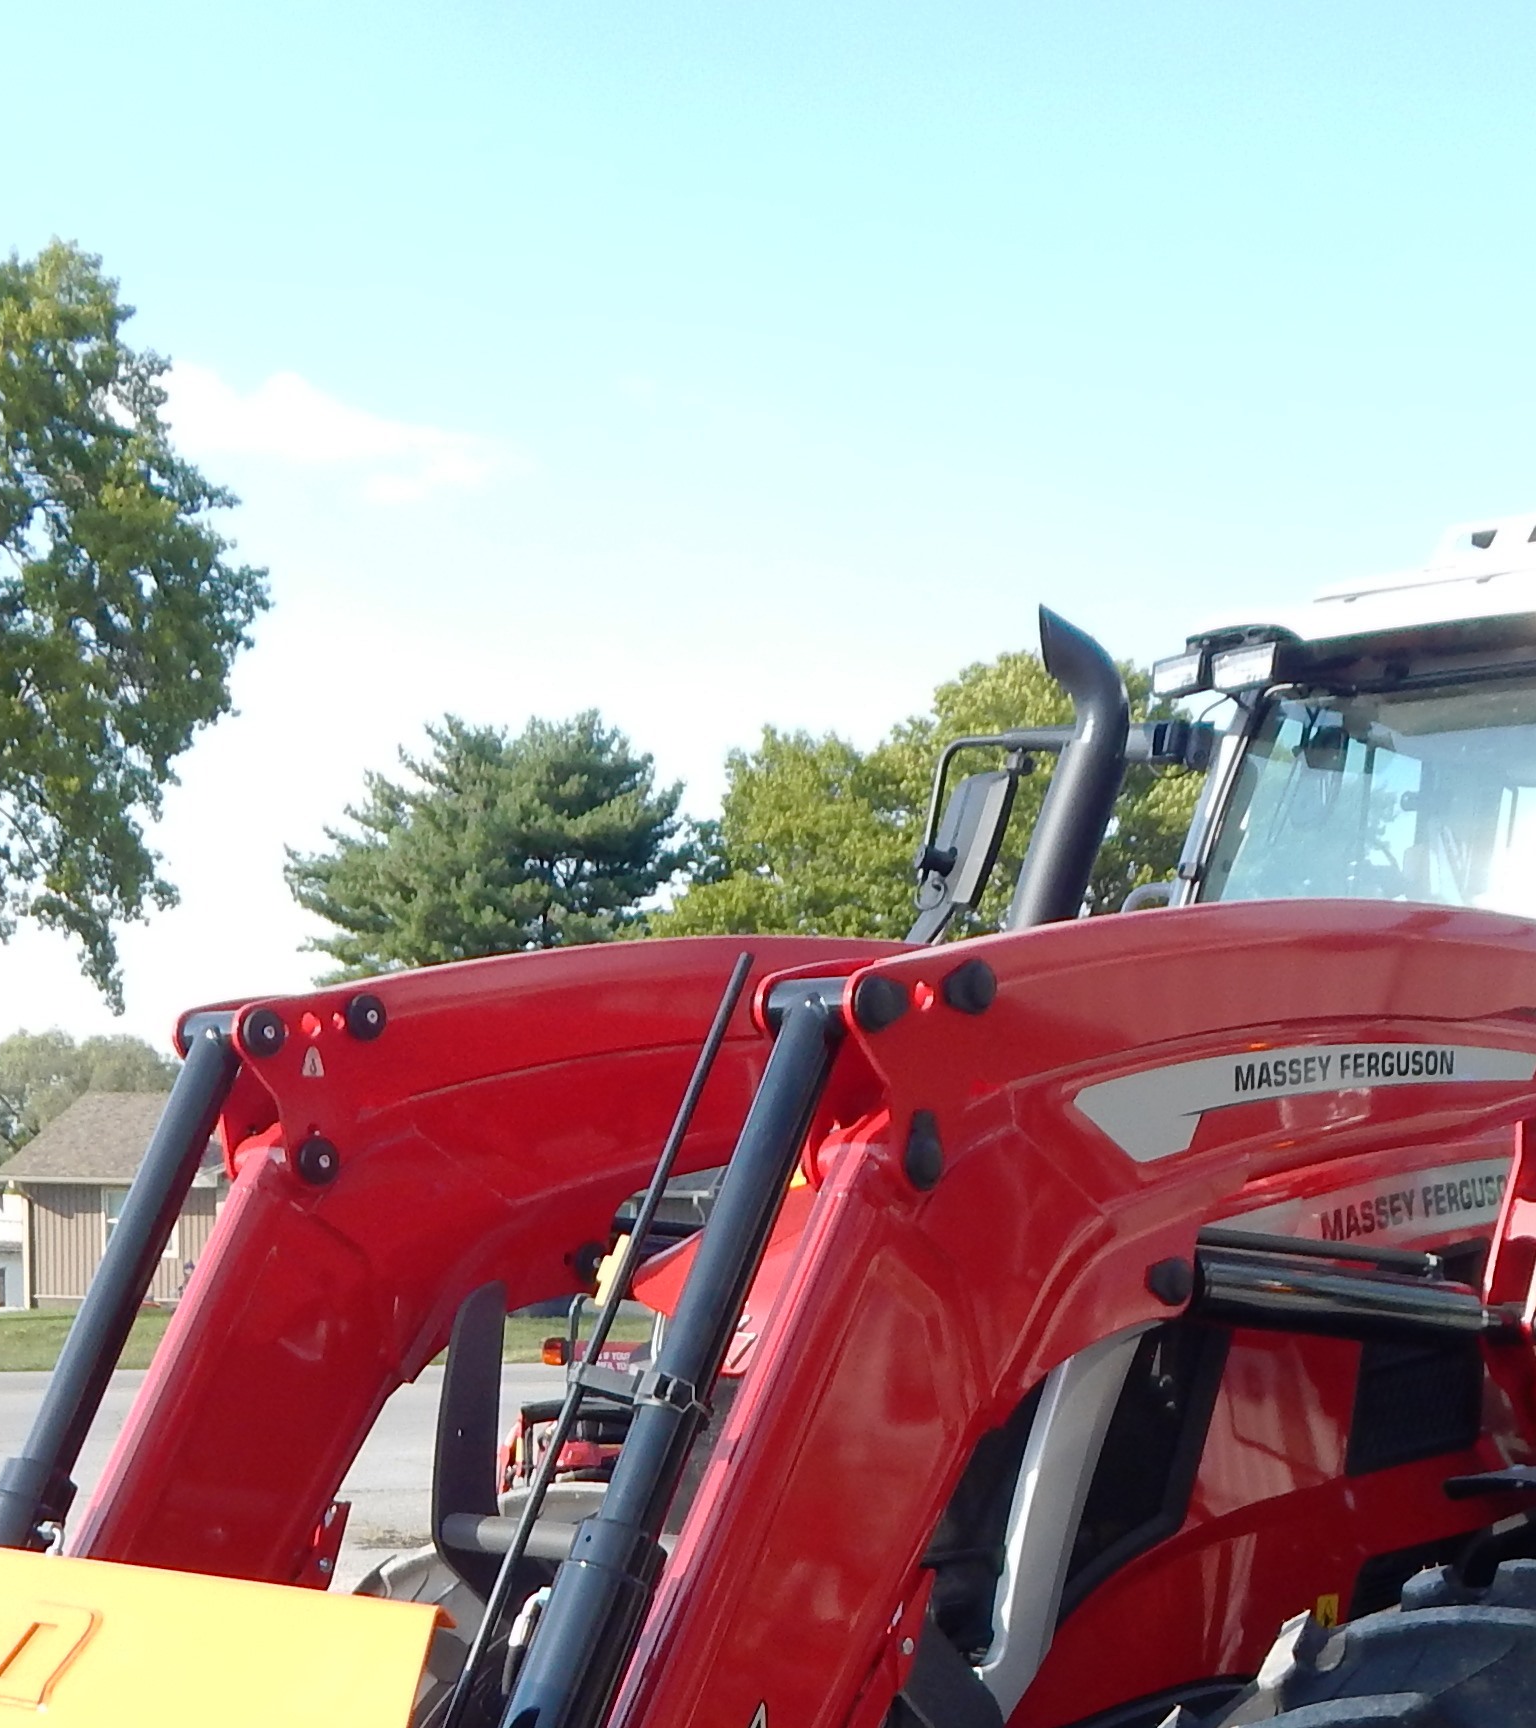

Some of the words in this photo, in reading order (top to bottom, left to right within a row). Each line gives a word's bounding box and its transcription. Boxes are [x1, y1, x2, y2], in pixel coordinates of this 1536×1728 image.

[1234, 1054, 1331, 1092] MASSEY
[1340, 1050, 1455, 1080] FERGUSON
[1320, 1188, 1414, 1241] MASSEY
[1422, 1174, 1508, 1219] FERGUSO
